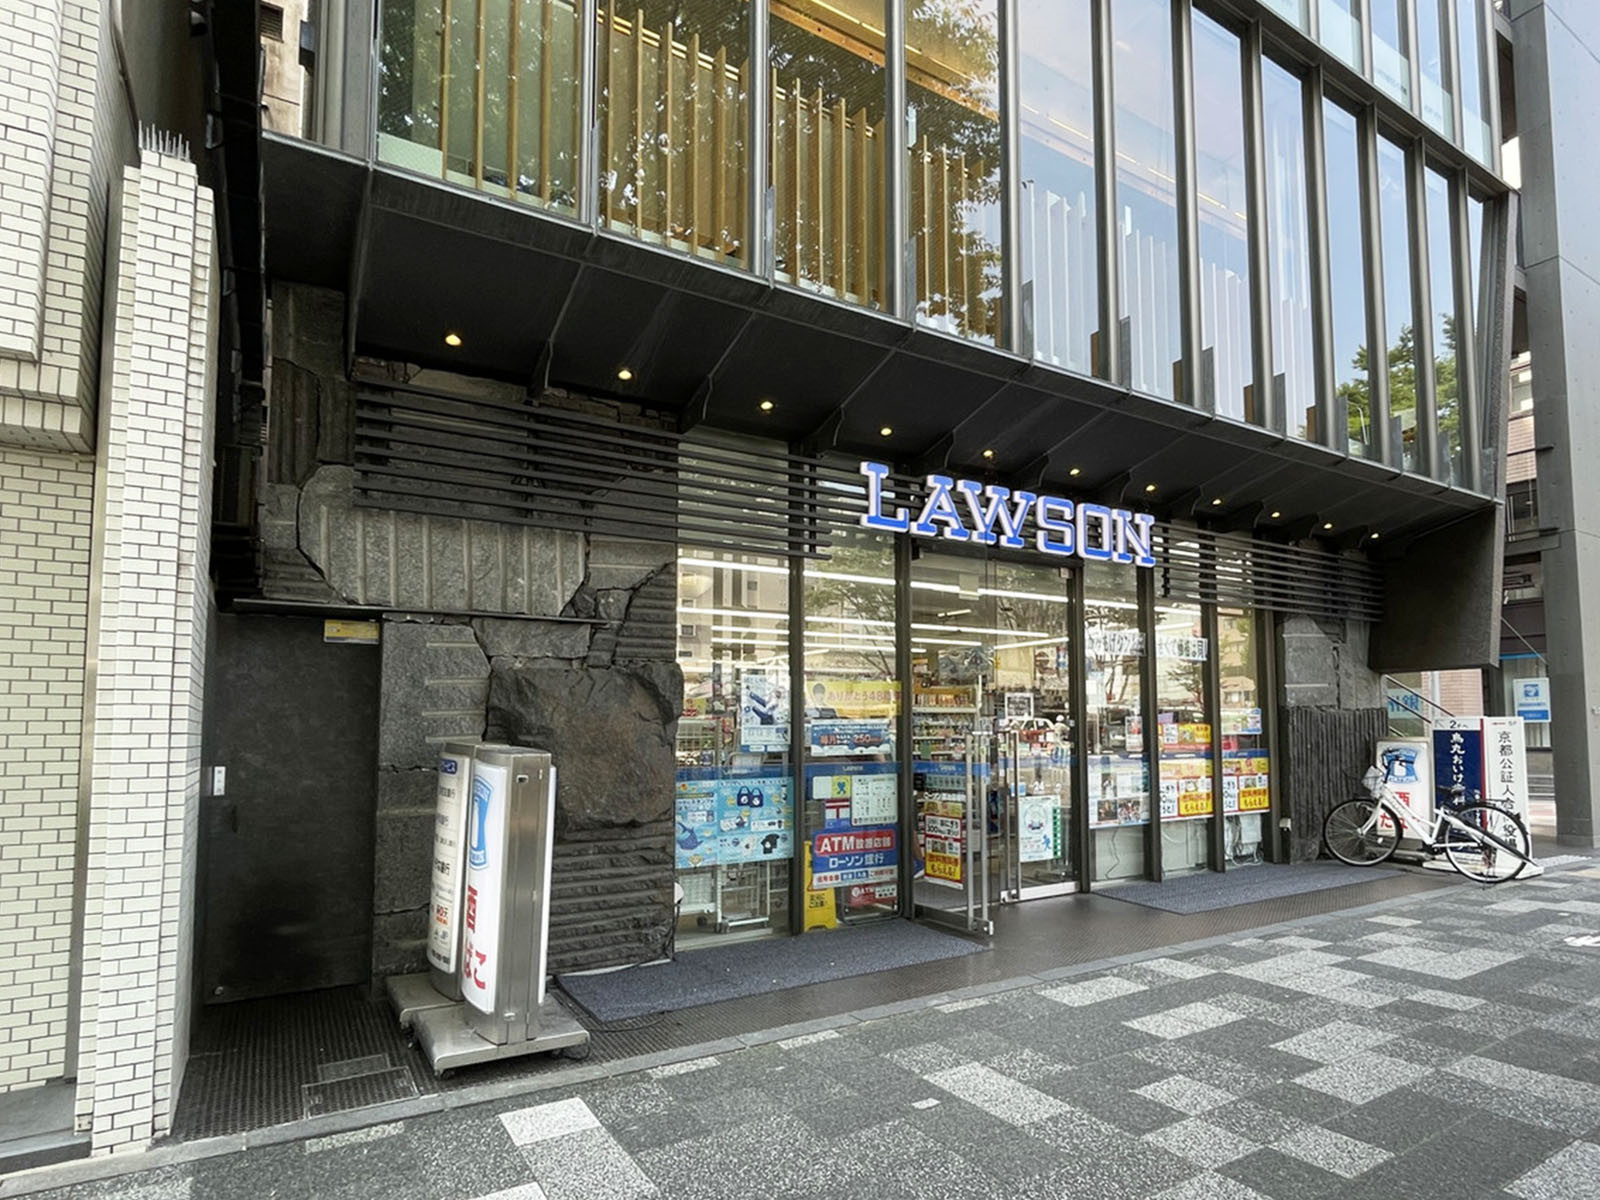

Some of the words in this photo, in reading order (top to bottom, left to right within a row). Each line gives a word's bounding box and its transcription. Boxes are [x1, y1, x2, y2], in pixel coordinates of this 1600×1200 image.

[860, 461, 1156, 568] LAWSON
[828, 853, 884, 869] ローソン銀行
